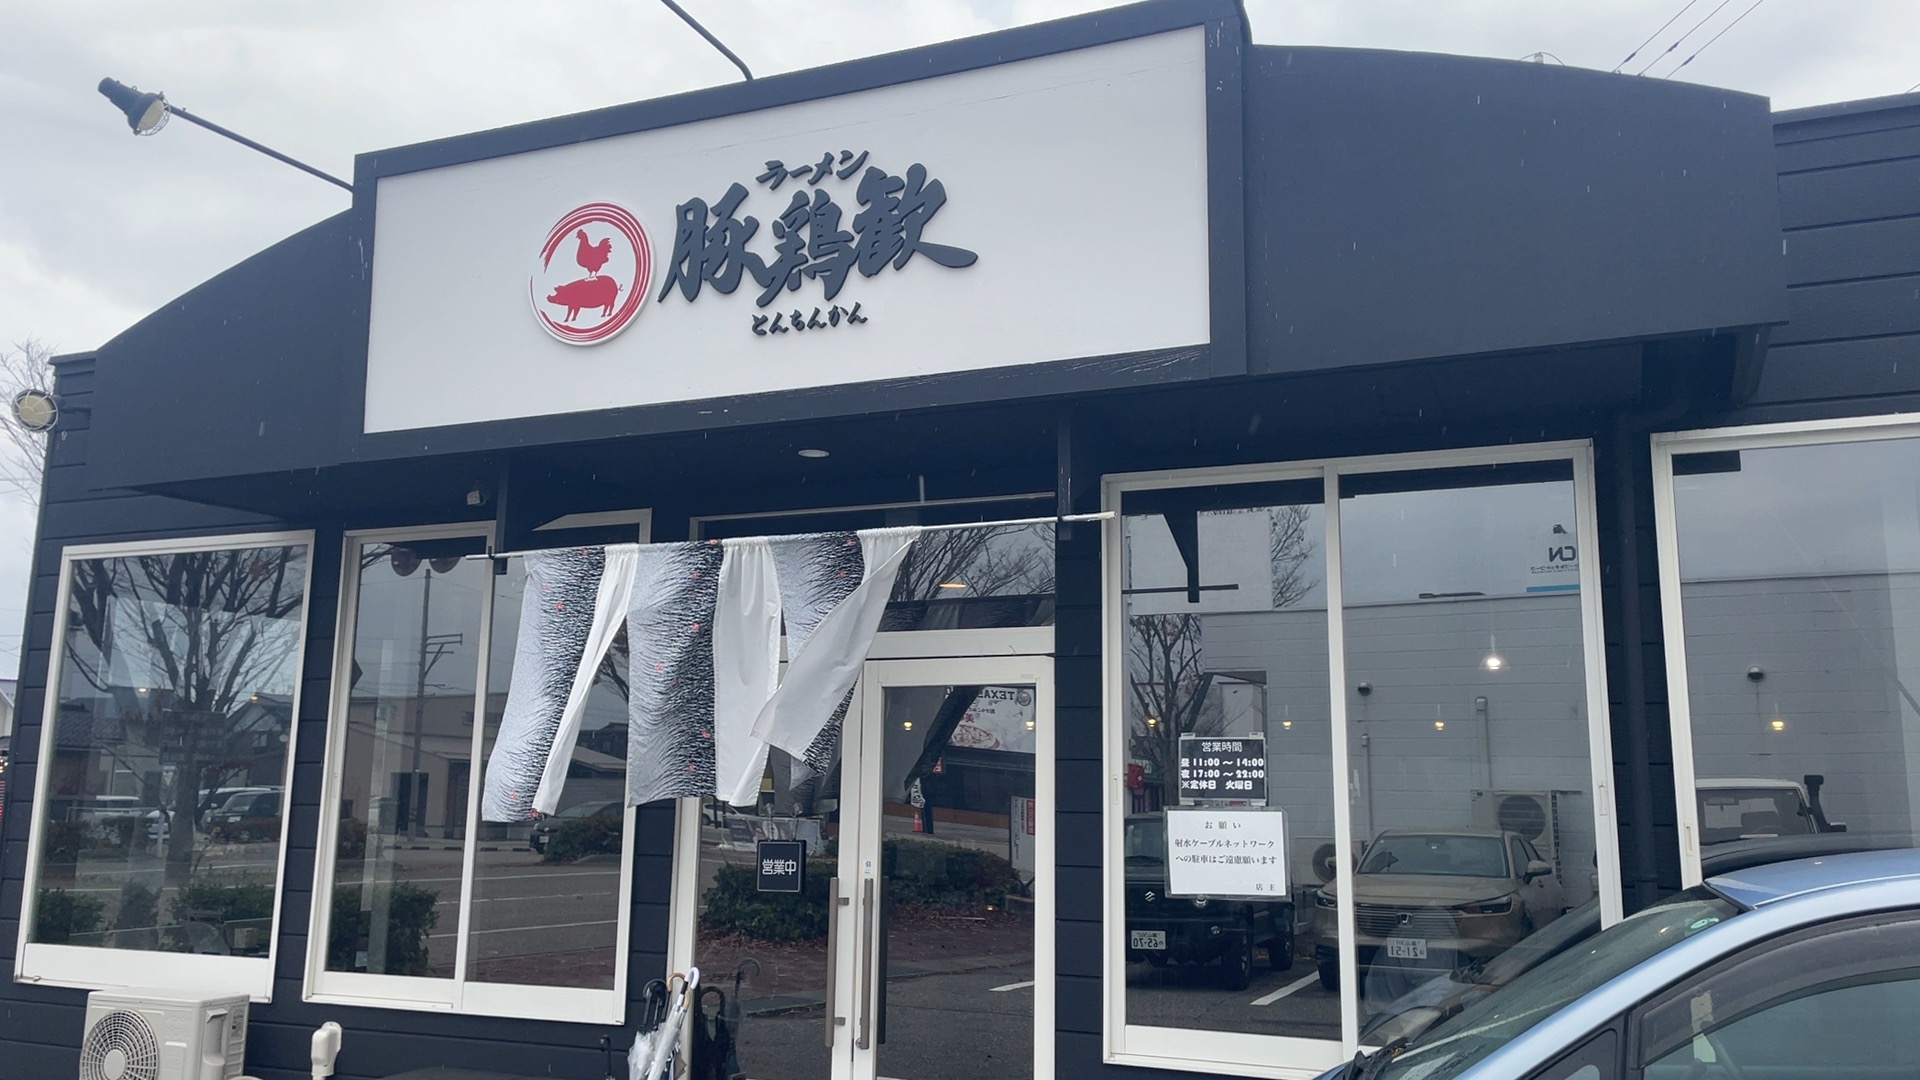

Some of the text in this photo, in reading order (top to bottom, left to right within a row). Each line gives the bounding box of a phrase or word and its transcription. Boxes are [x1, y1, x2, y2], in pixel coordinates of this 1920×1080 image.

[756, 150, 869, 190] ラーメン
[657, 163, 978, 307] 豚鶏歓
[752, 302, 867, 335] とんちんかん
[1202, 742, 1242, 752] 営業時間
[1193, 758, 1220, 767] 11:00
[1236, 758, 1264, 767] 14:00
[1193, 770, 1220, 778] 17:00
[1235, 770, 1265, 779] 22:00
[1225, 780, 1253, 790] 火曜日
[1205, 821, 1241, 829] お願い
[1174, 839, 1275, 848] 射水ケーブルネットワーク
[1175, 855, 1277, 864] への駐車はご遠慮願います
[762, 859, 797, 875] 営業中
